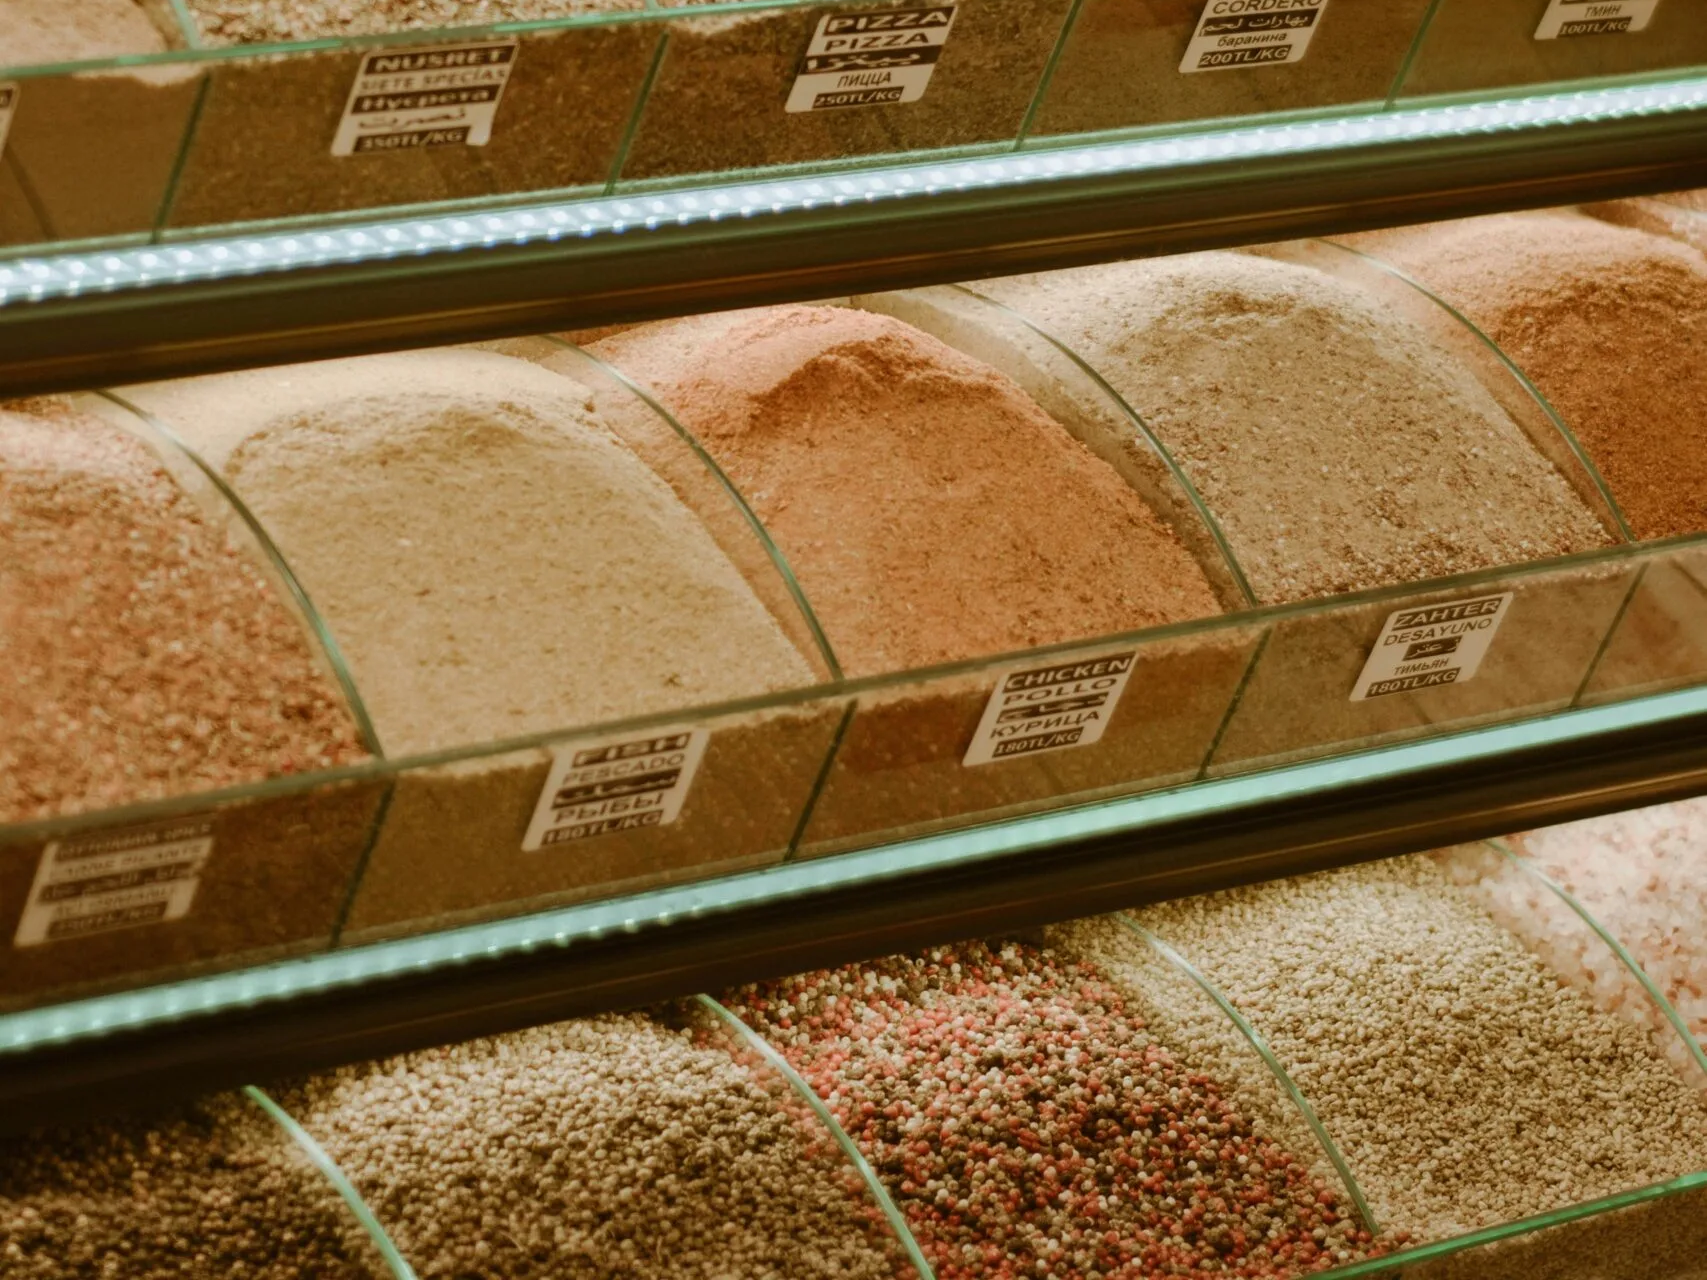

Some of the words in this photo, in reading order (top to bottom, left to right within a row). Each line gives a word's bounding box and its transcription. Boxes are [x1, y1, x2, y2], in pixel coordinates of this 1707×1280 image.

[1249, 14, 1308, 28] بهارات
[1584, 4, 1622, 18] ТМИН
[827, 11, 948, 32] PIZZA
[1201, 19, 1243, 36] لحم
[1560, 21, 1629, 35] 100TL/KG
[824, 32, 929, 52] PIZZA
[1218, 33, 1287, 47] баранина
[375, 48, 507, 72] NUSRET
[1200, 47, 1289, 65] 200TL/KG
[837, 72, 892, 88] ПИЦЦА
[815, 90, 900, 106] 250TL/KG
[1394, 601, 1501, 627] ZAHTER
[1383, 618, 1492, 646] DESAYUNO
[1007, 658, 1130, 688] CHICKEN
[1394, 658, 1449, 676] ТИМЬЯН
[1003, 678, 1117, 705] POLLO
[1370, 670, 1457, 695] 180TL/KG
[990, 710, 1100, 740] КУРИЦА
[995, 730, 1080, 754] 180TL/KG
[563, 752, 685, 785] PESCADO
